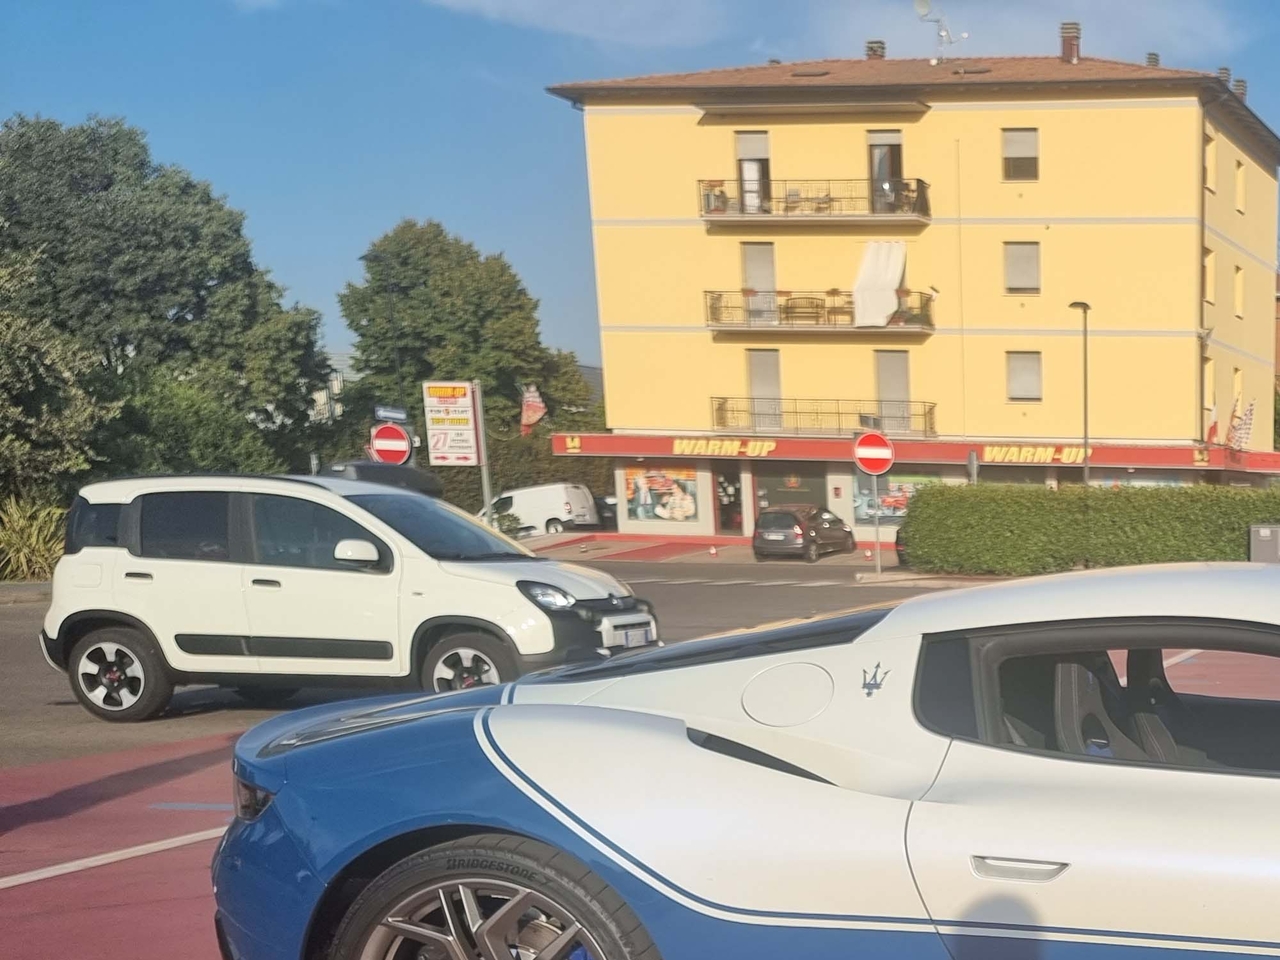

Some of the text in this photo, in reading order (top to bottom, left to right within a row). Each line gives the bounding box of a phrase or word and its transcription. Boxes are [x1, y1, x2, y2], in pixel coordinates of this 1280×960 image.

[672, 438, 777, 457] WARM-UP
[983, 445, 1093, 464] WARM-UP
[446, 858, 538, 881] BRIDGESTONE
